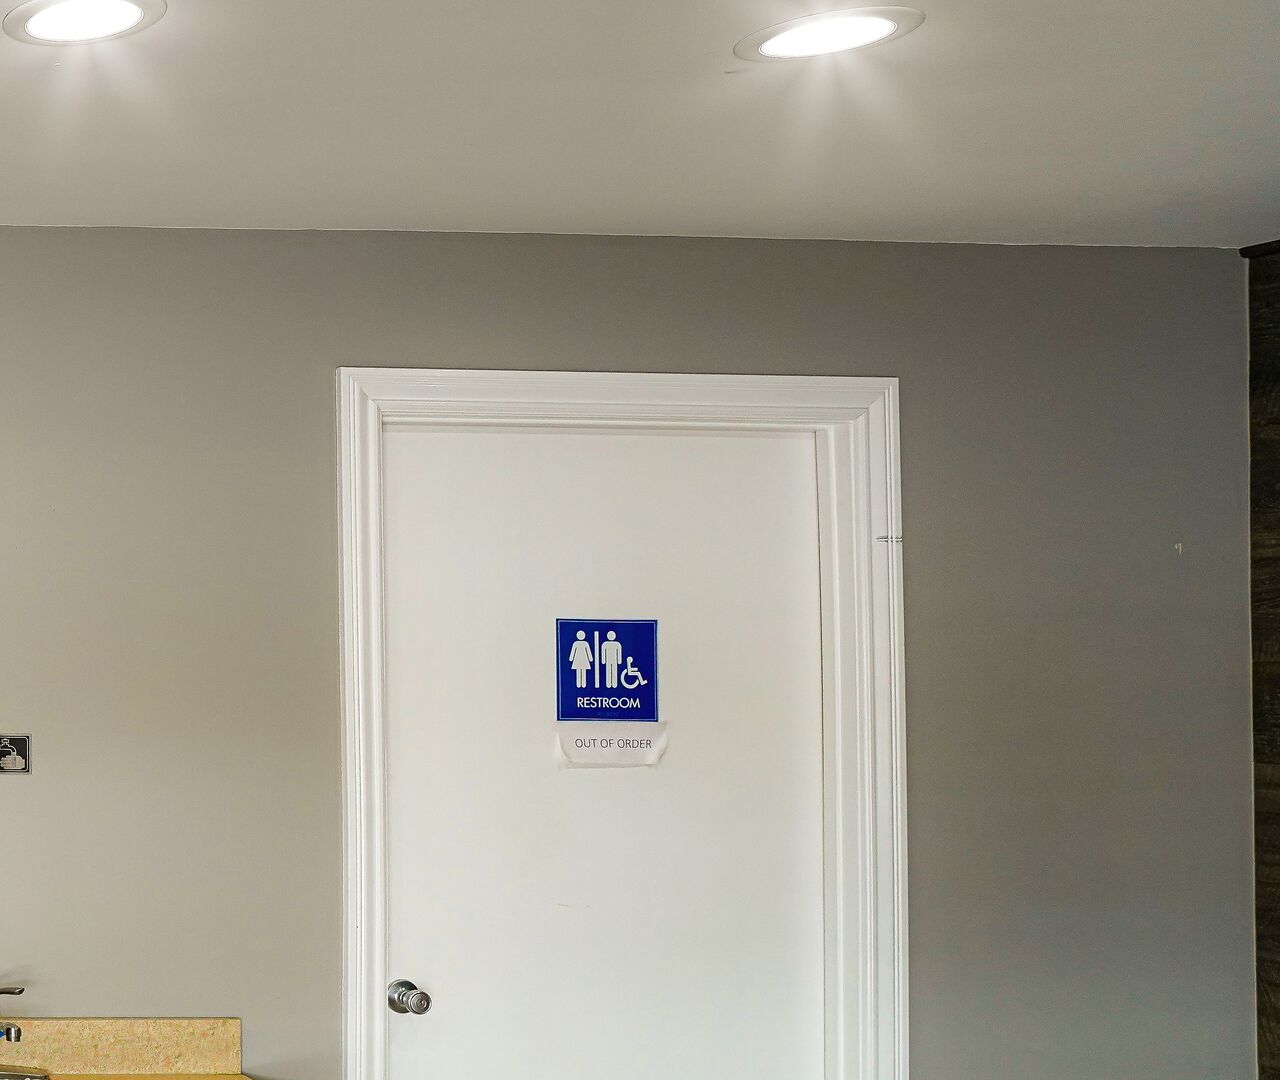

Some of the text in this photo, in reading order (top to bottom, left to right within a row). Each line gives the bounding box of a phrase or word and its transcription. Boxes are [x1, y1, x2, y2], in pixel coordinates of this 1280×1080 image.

[577, 696, 641, 708] RESTROOM
[574, 738, 652, 748] OUT OF ORDER
